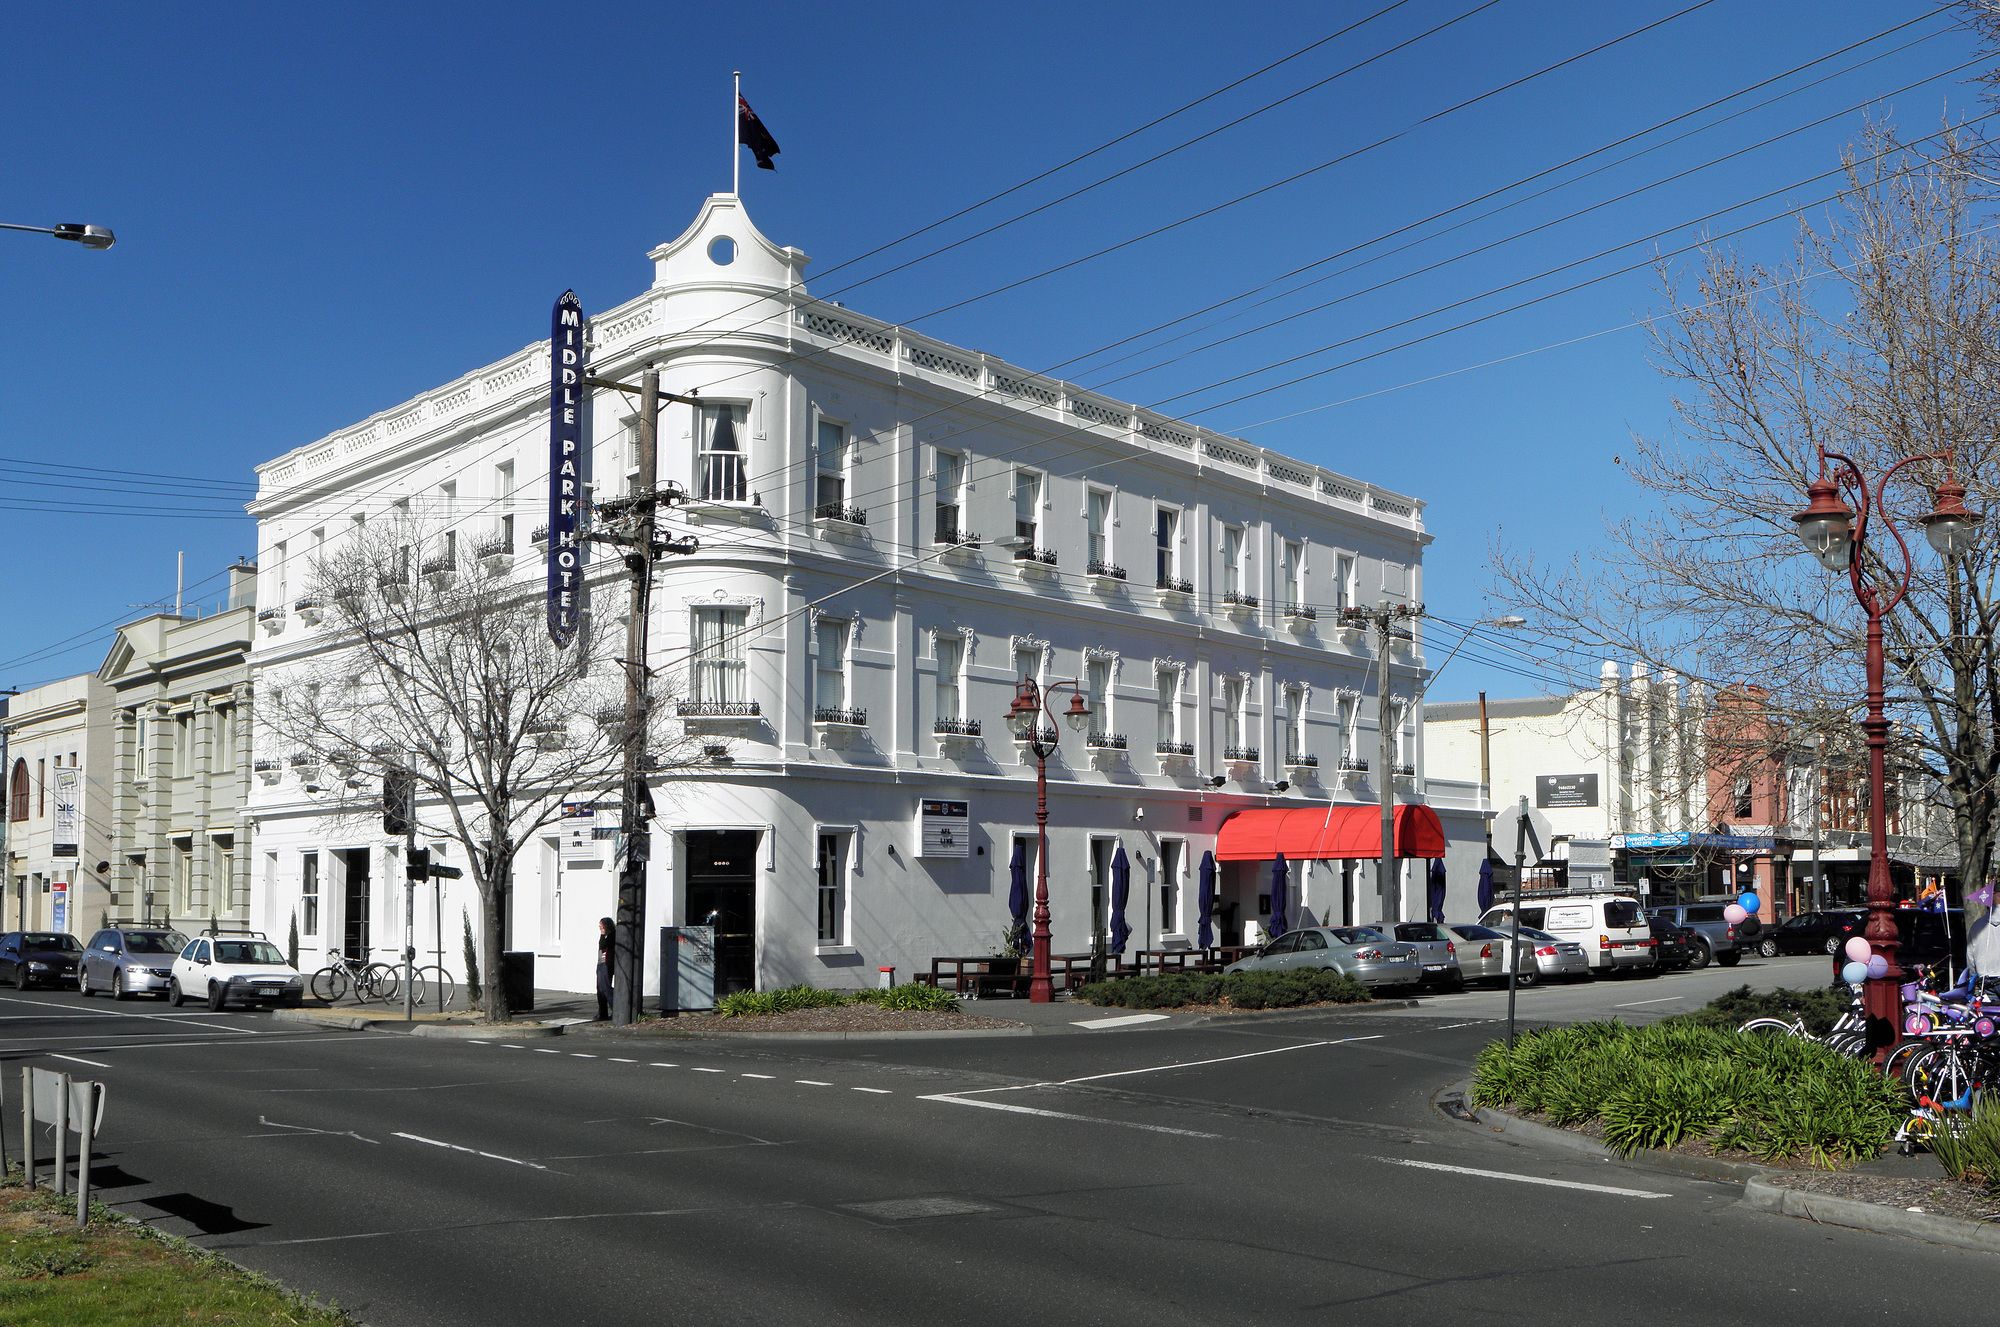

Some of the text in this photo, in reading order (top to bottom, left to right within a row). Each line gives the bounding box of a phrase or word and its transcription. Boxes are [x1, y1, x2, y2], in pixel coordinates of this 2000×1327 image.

[558, 309, 578, 628] MIDDLE PARK HOTEL
